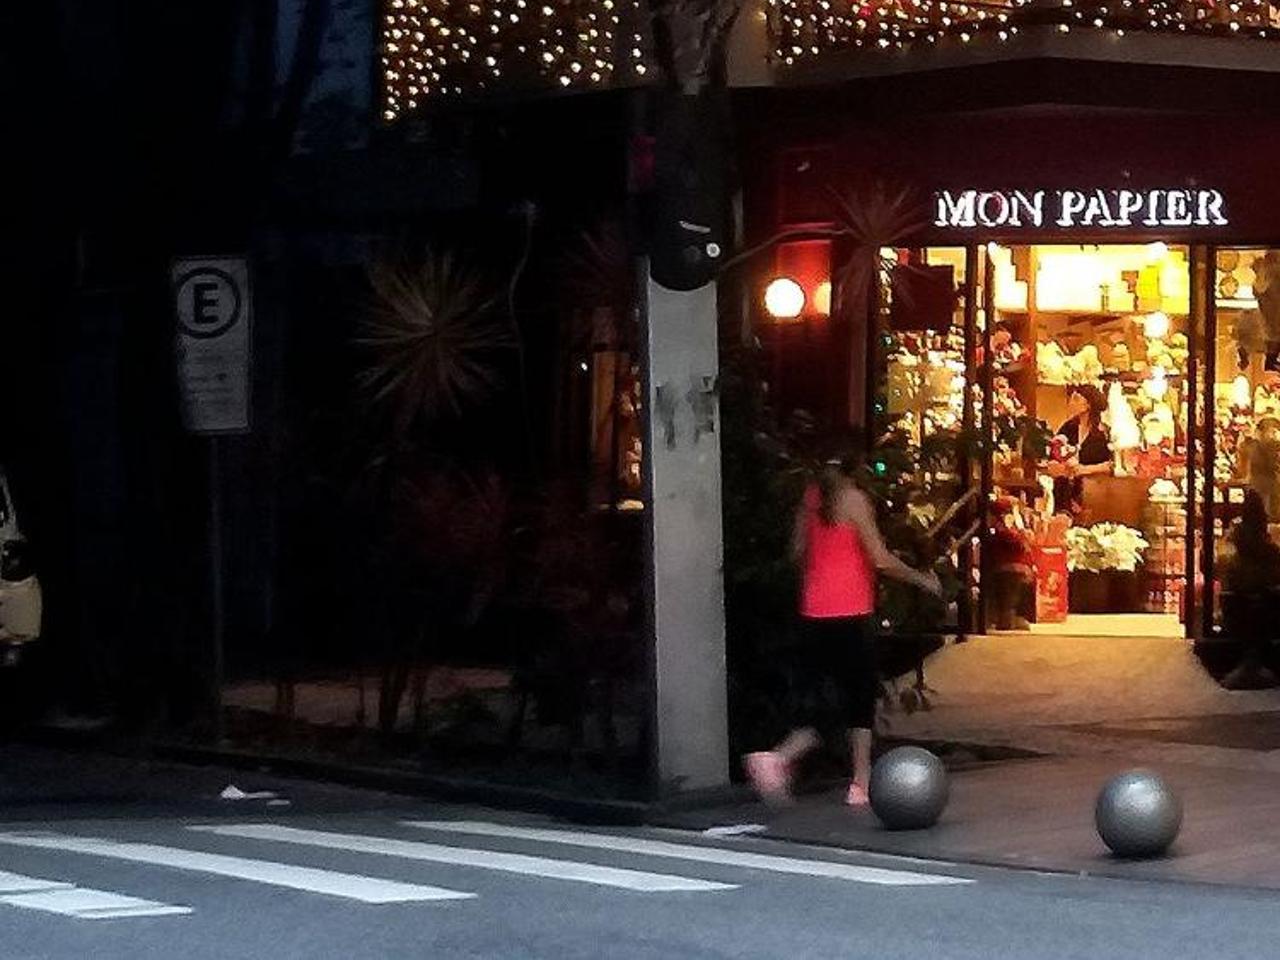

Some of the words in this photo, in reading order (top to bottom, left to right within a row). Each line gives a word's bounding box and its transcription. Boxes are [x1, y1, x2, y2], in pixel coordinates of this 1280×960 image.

[934, 189, 1046, 228] MON
[1056, 188, 1229, 228] PAPIER
[193, 281, 220, 325] E
